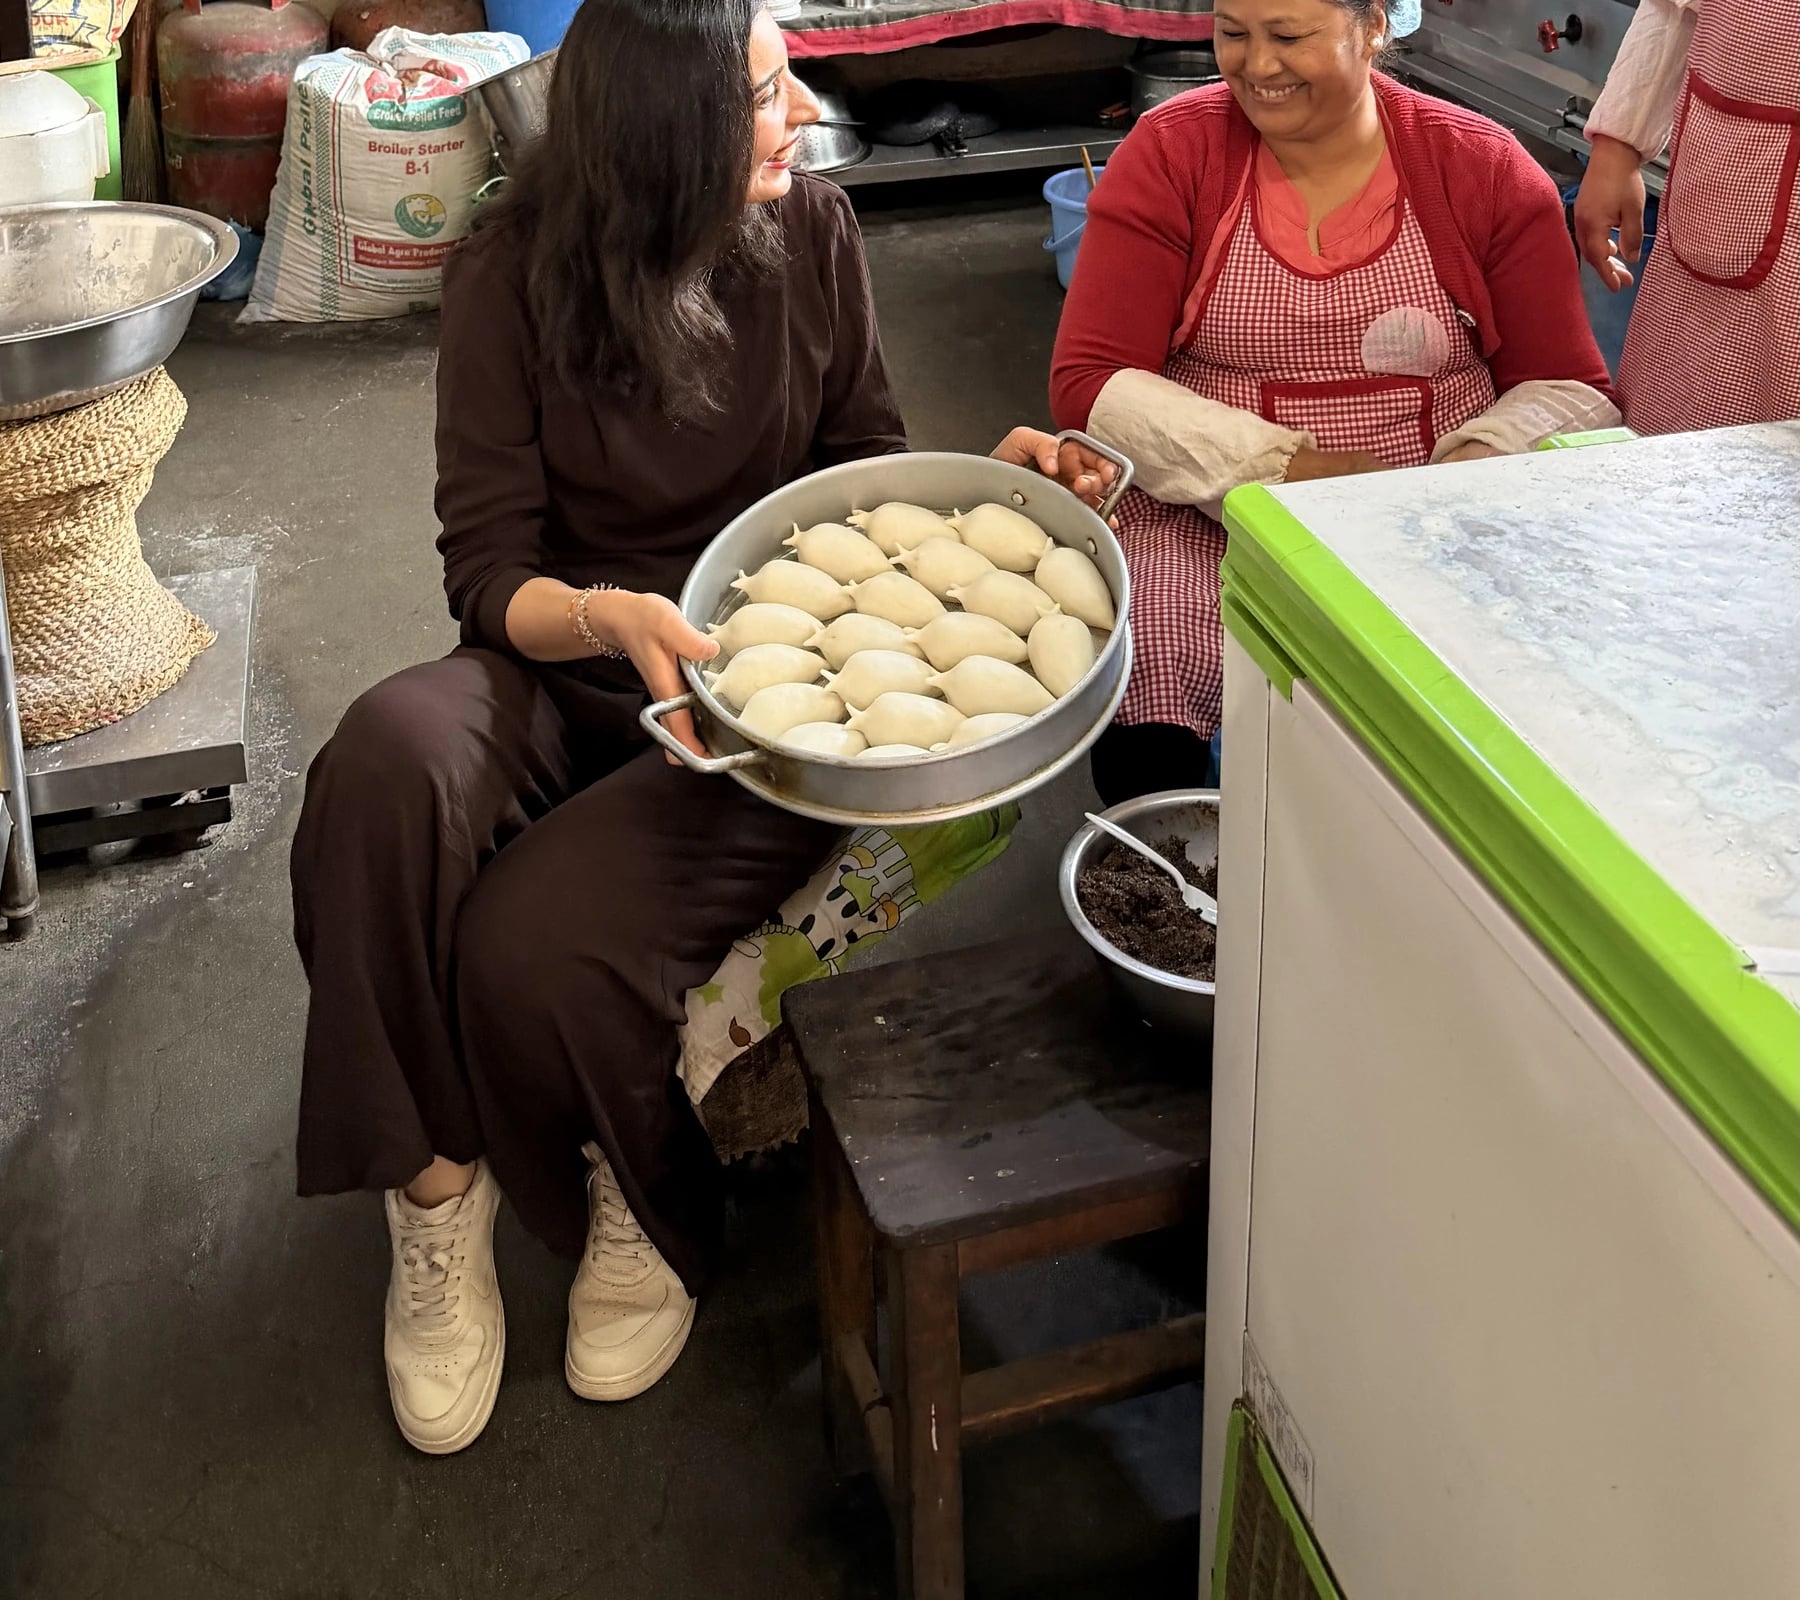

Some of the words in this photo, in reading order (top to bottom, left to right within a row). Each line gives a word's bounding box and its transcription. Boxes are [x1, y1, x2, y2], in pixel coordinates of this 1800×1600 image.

[439, 105, 462, 118] Feed
[368, 140, 415, 156] Broiler
[418, 139, 465, 156] Starter
[405, 160, 430, 175] B-1
[357, 240, 386, 254] Global
[388, 246, 411, 258] Agro
